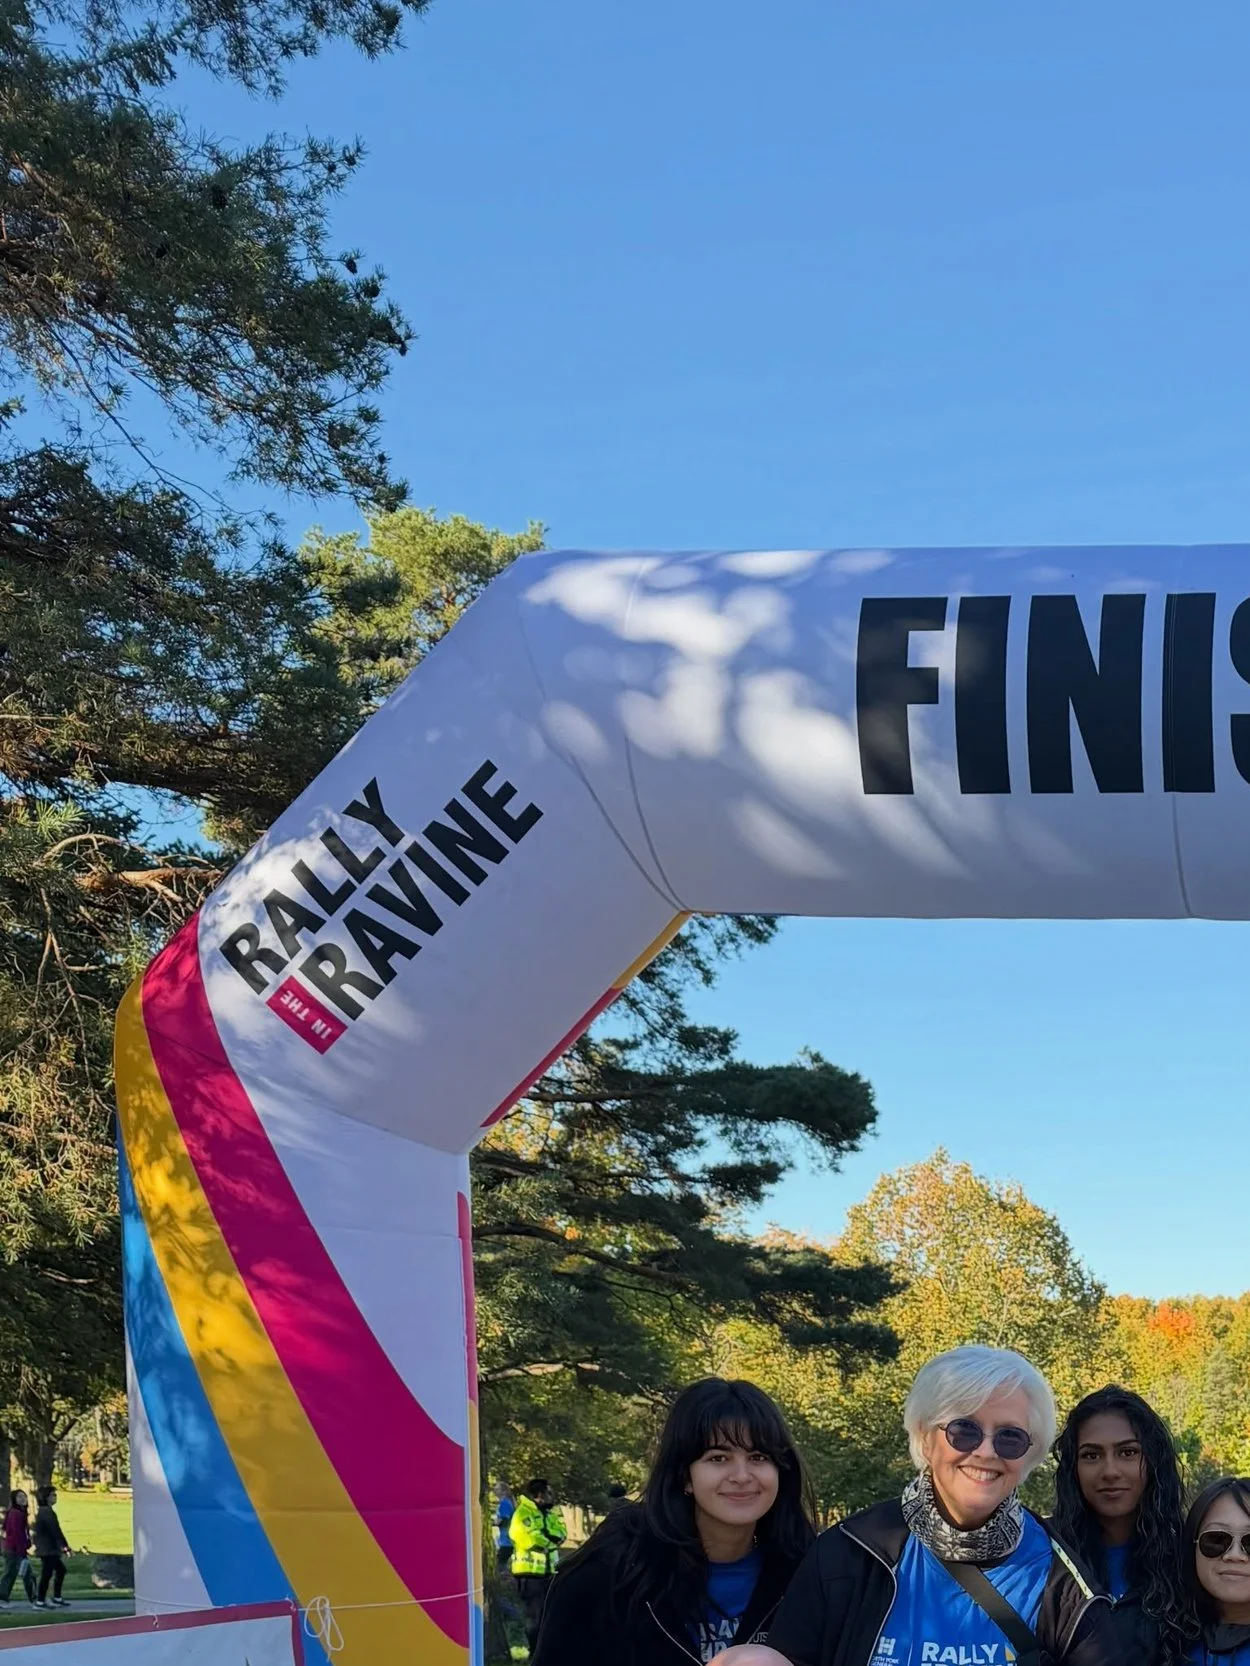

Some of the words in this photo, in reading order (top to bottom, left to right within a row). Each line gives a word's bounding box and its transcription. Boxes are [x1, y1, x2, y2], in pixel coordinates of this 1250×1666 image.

[219, 777, 405, 995] RALLY
[299, 759, 544, 1021] RAVINE
[280, 990, 310, 1021] THE
[310, 1018, 332, 1040] IN
[922, 1642, 998, 1665] RALLY
